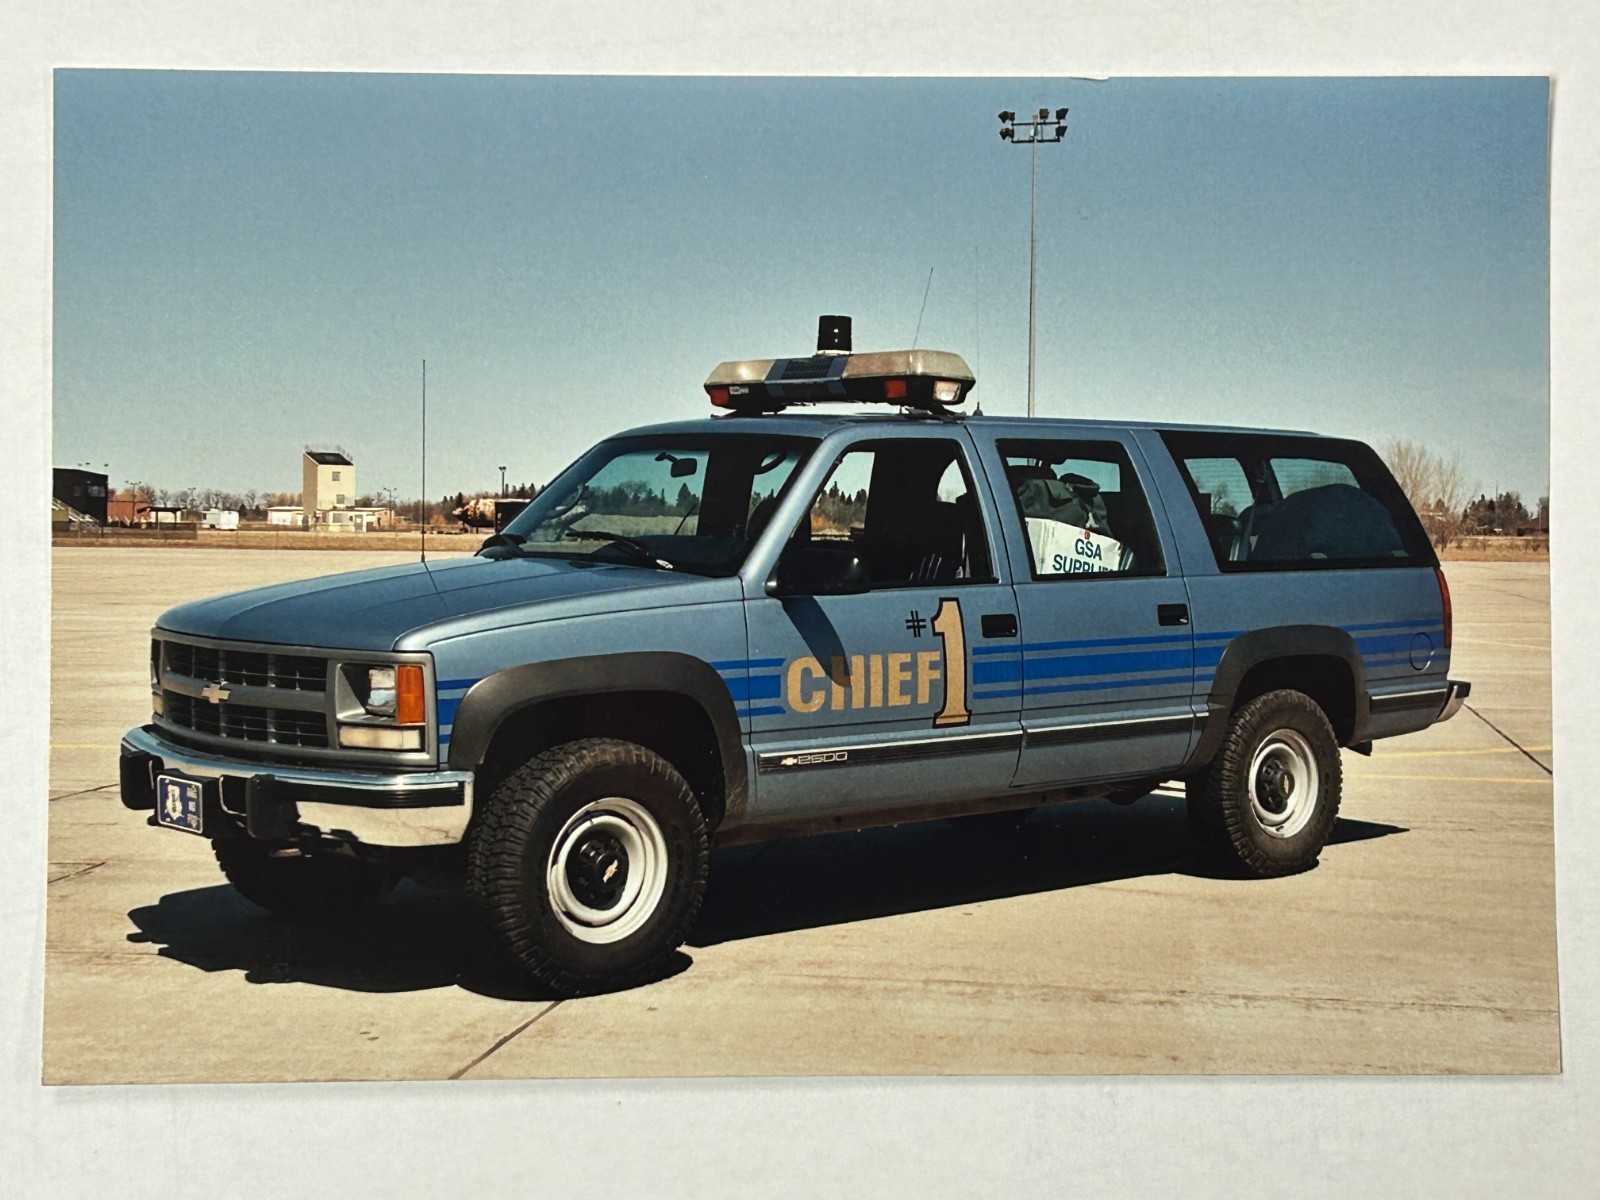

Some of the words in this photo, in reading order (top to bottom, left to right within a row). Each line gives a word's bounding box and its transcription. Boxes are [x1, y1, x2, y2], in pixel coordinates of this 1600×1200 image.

[1074, 538, 1102, 561] GSA
[787, 651, 941, 713] CHIEF
[797, 751, 848, 765] 2500
